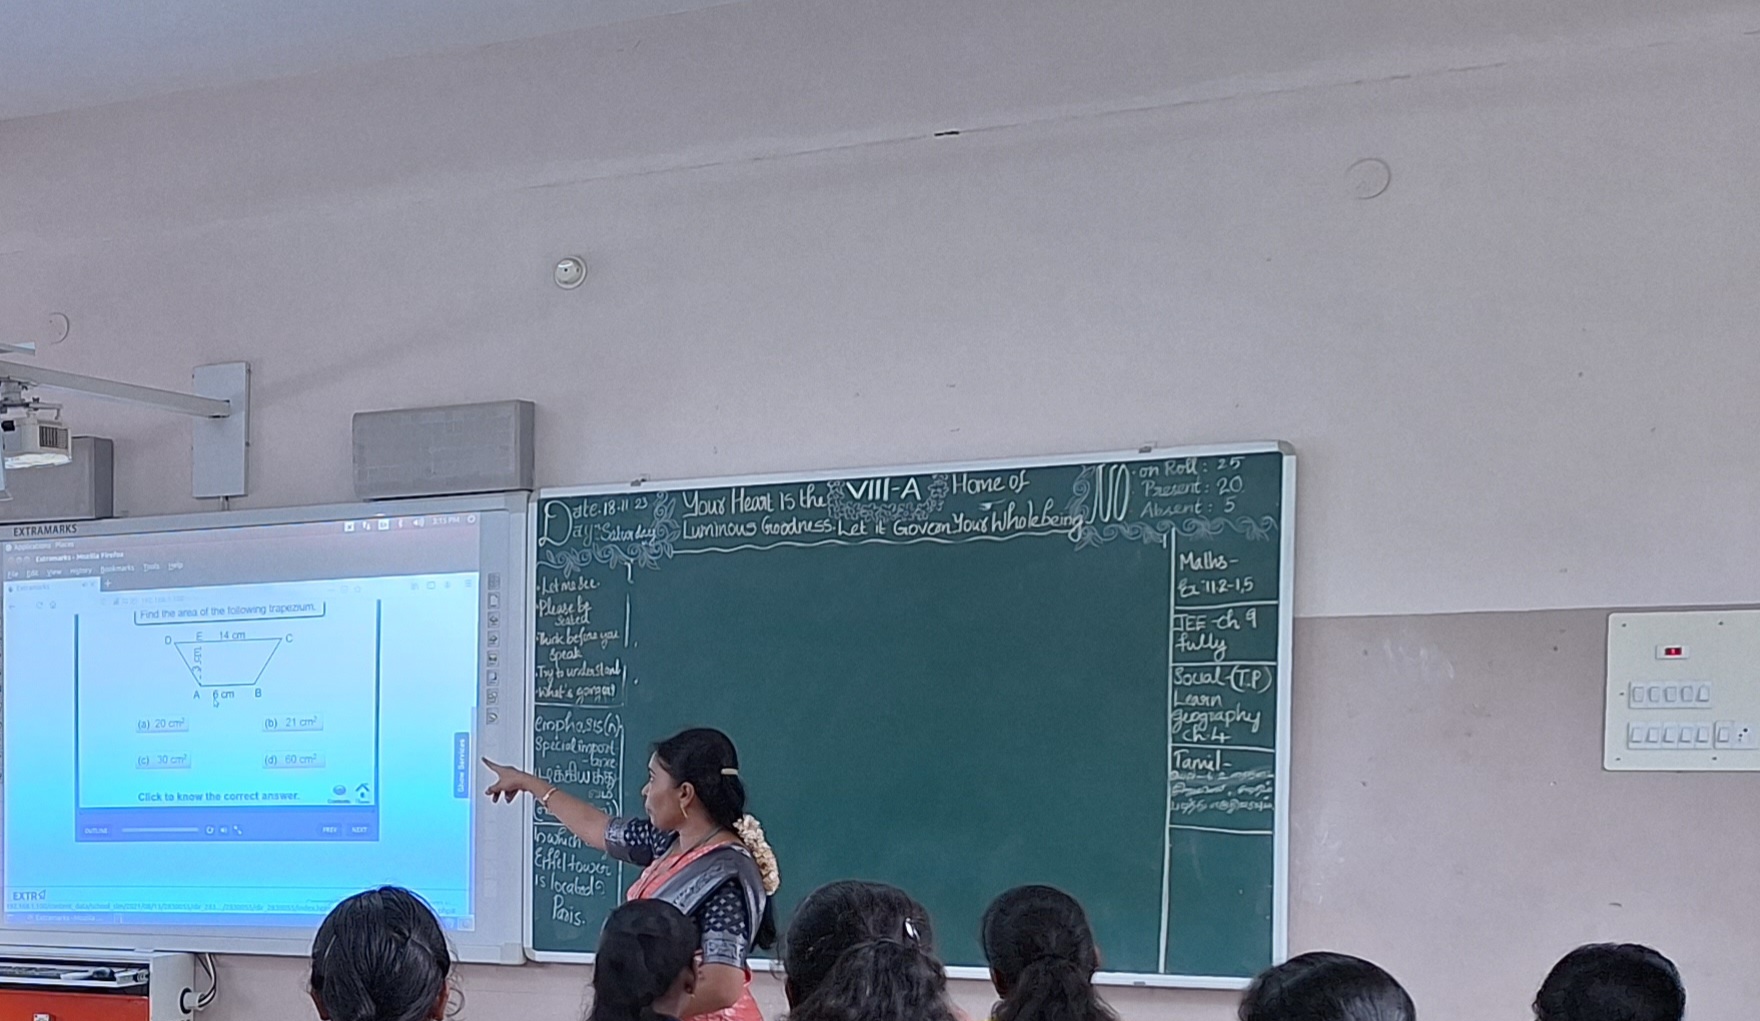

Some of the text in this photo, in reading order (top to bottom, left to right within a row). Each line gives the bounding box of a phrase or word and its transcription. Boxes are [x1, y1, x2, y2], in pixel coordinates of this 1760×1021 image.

[1009, 469, 1030, 493] of
[846, 477, 921, 501] VIII-A
[683, 491, 725, 518] Your
[14, 524, 77, 537] EXTRAMARKS
[683, 520, 756, 539] Luminous
[838, 519, 868, 535] Let
[952, 512, 988, 535] Your
[100, 563, 135, 574] Bookmarks
[140, 609, 159, 620] Find
[161, 609, 175, 619] the
[177, 608, 198, 618] area
[199, 606, 209, 617] of
[211, 606, 225, 616] the
[227, 604, 267, 616] following
[231, 631, 246, 640] cm
[221, 691, 235, 699] cm
[137, 719, 150, 730] (a)
[155, 718, 166, 728] 20
[264, 718, 278, 729] (b)
[285, 717, 296, 727] 21
[137, 756, 150, 766] (c)
[264, 755, 278, 766] (d)
[138, 792, 162, 802] Click
[164, 793, 174, 802] to
[176, 792, 202, 801] know
[205, 791, 221, 801] the
[223, 791, 259, 801] correct
